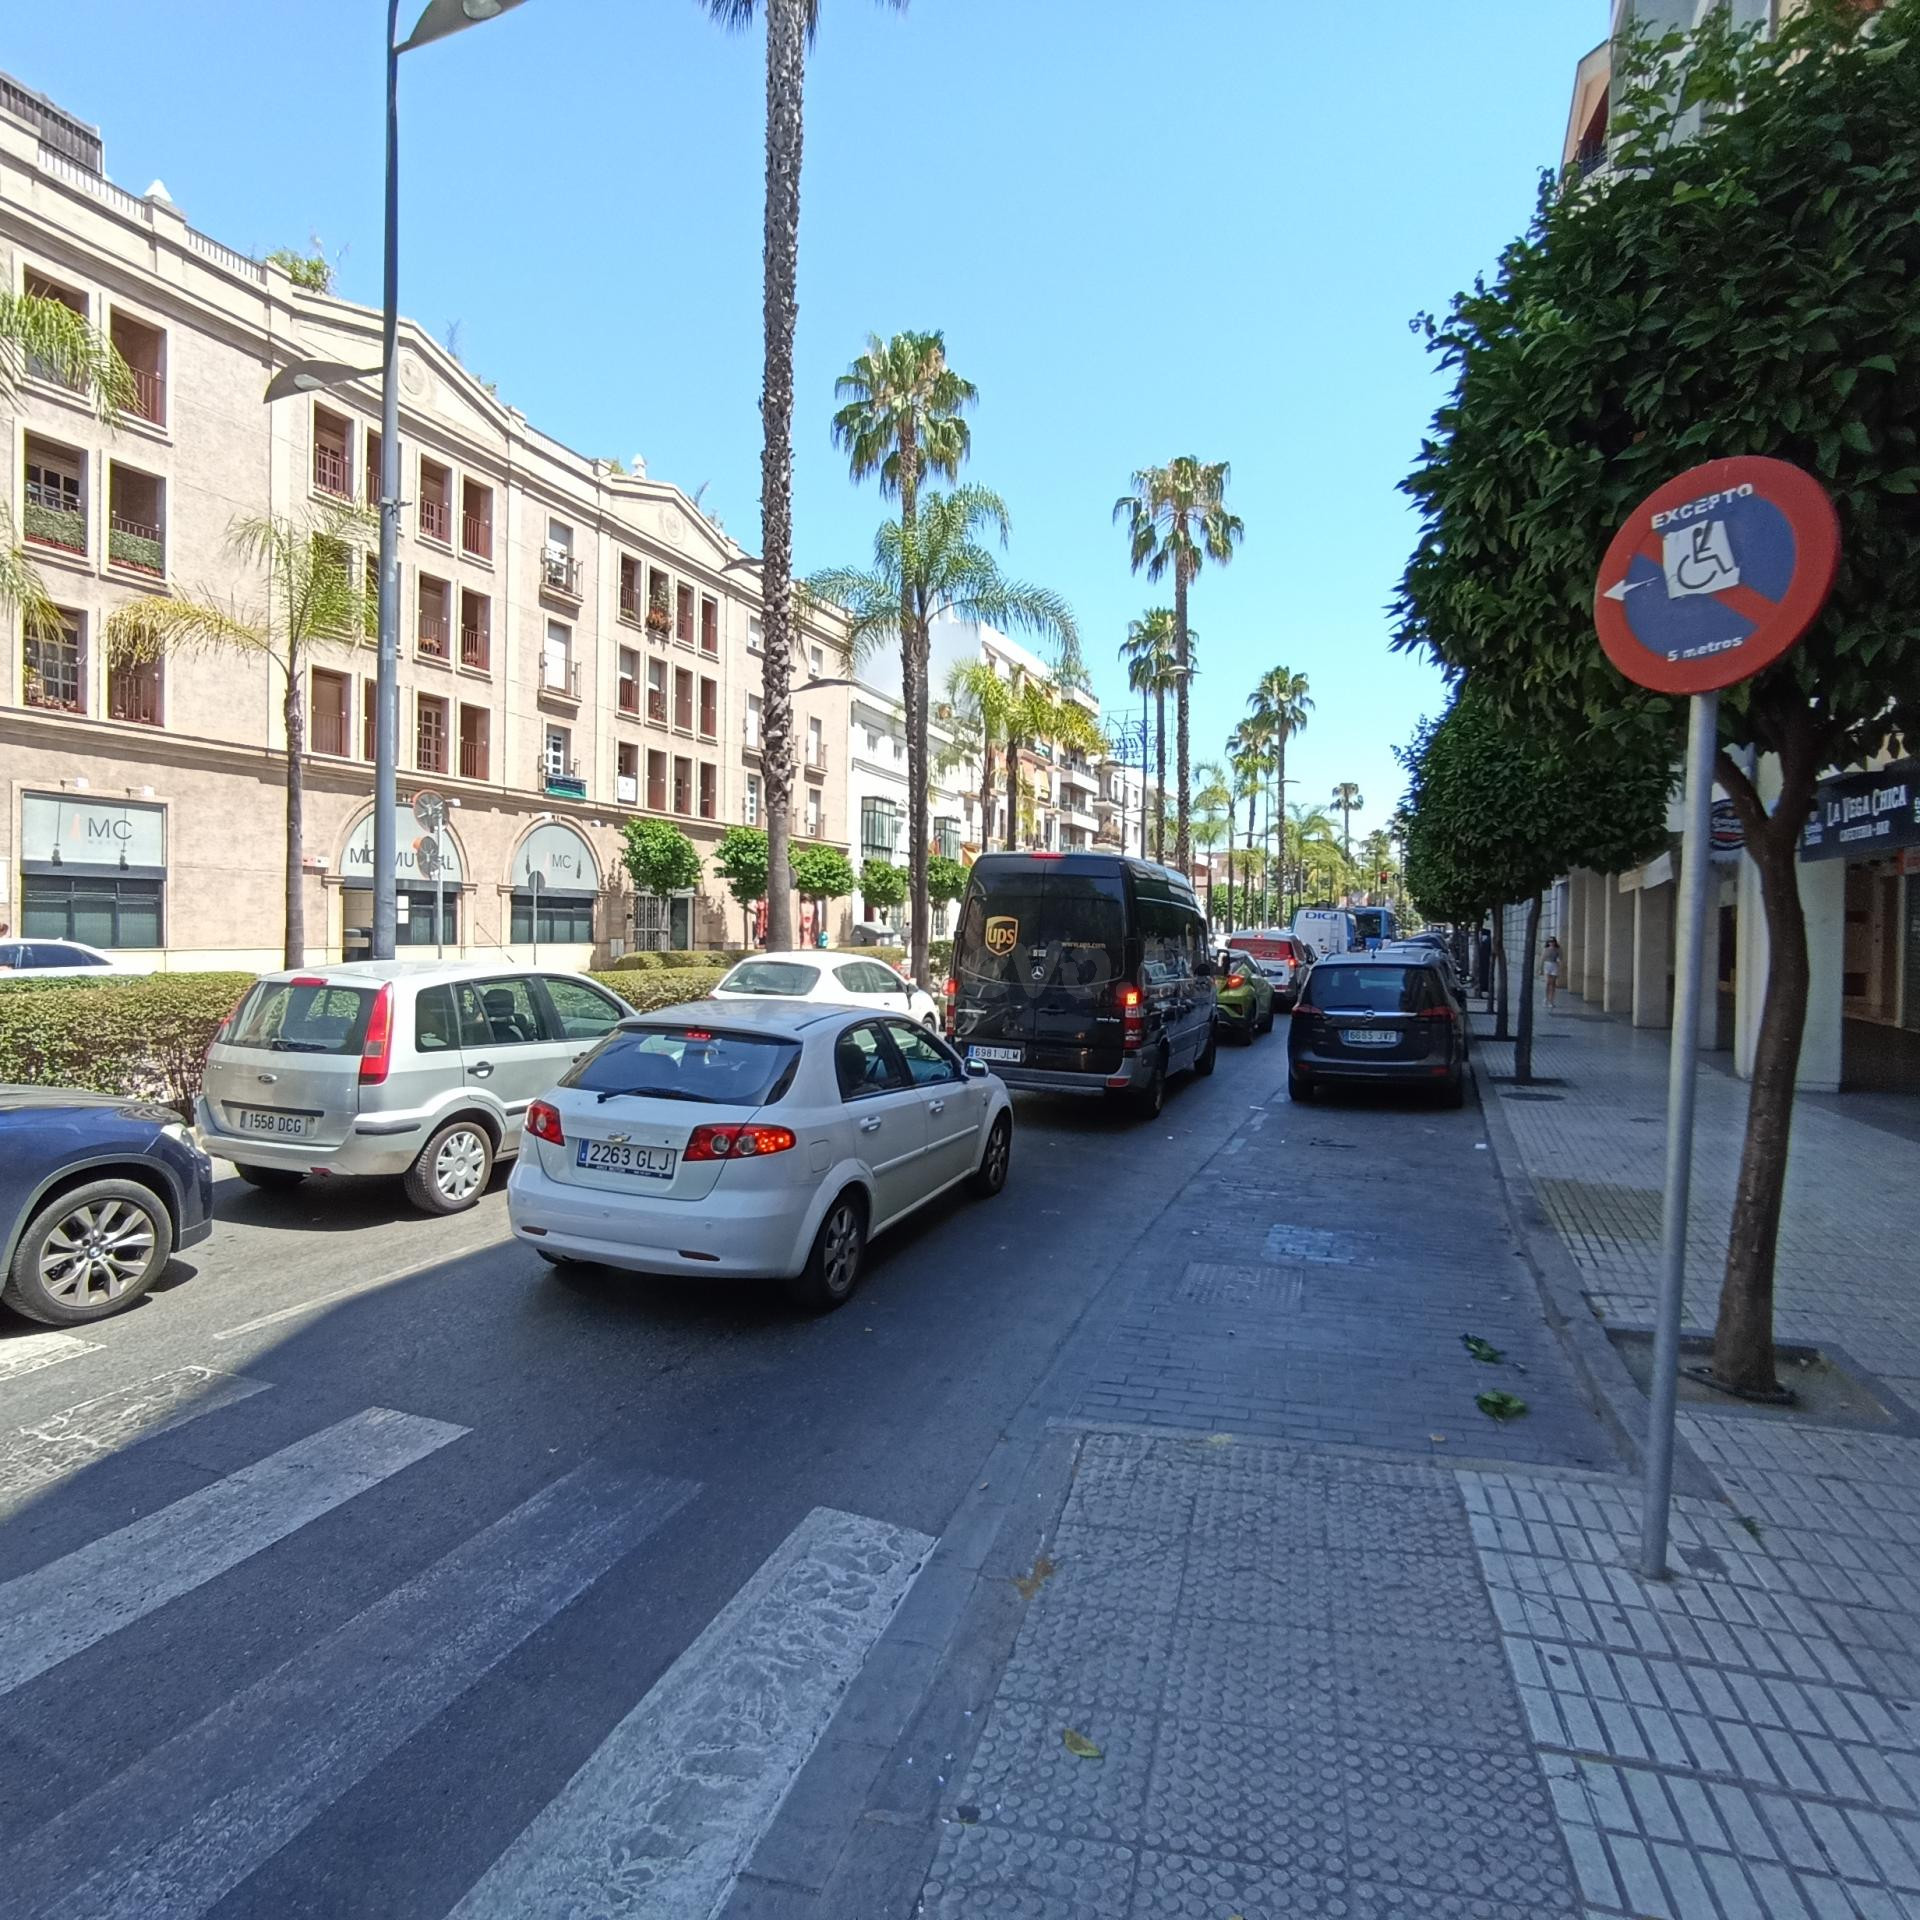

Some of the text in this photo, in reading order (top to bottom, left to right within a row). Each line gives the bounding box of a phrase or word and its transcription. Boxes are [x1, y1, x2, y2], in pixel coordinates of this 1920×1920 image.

[1652, 483, 1753, 530] EXCEPTO
[1667, 637, 1744, 661] 5 metros
[1842, 796, 1870, 823] VEGA
[1872, 785, 1907, 816] CHICA
[88, 817, 133, 840] MC
[551, 853, 572, 869] MC
[1305, 911, 1338, 921] DIGI
[988, 928, 1015, 949] ups
[975, 1047, 997, 1058] 6981
[250, 1113, 274, 1130] 1558
[590, 1143, 631, 1166] 2263
[636, 1150, 670, 1171] GLJ
